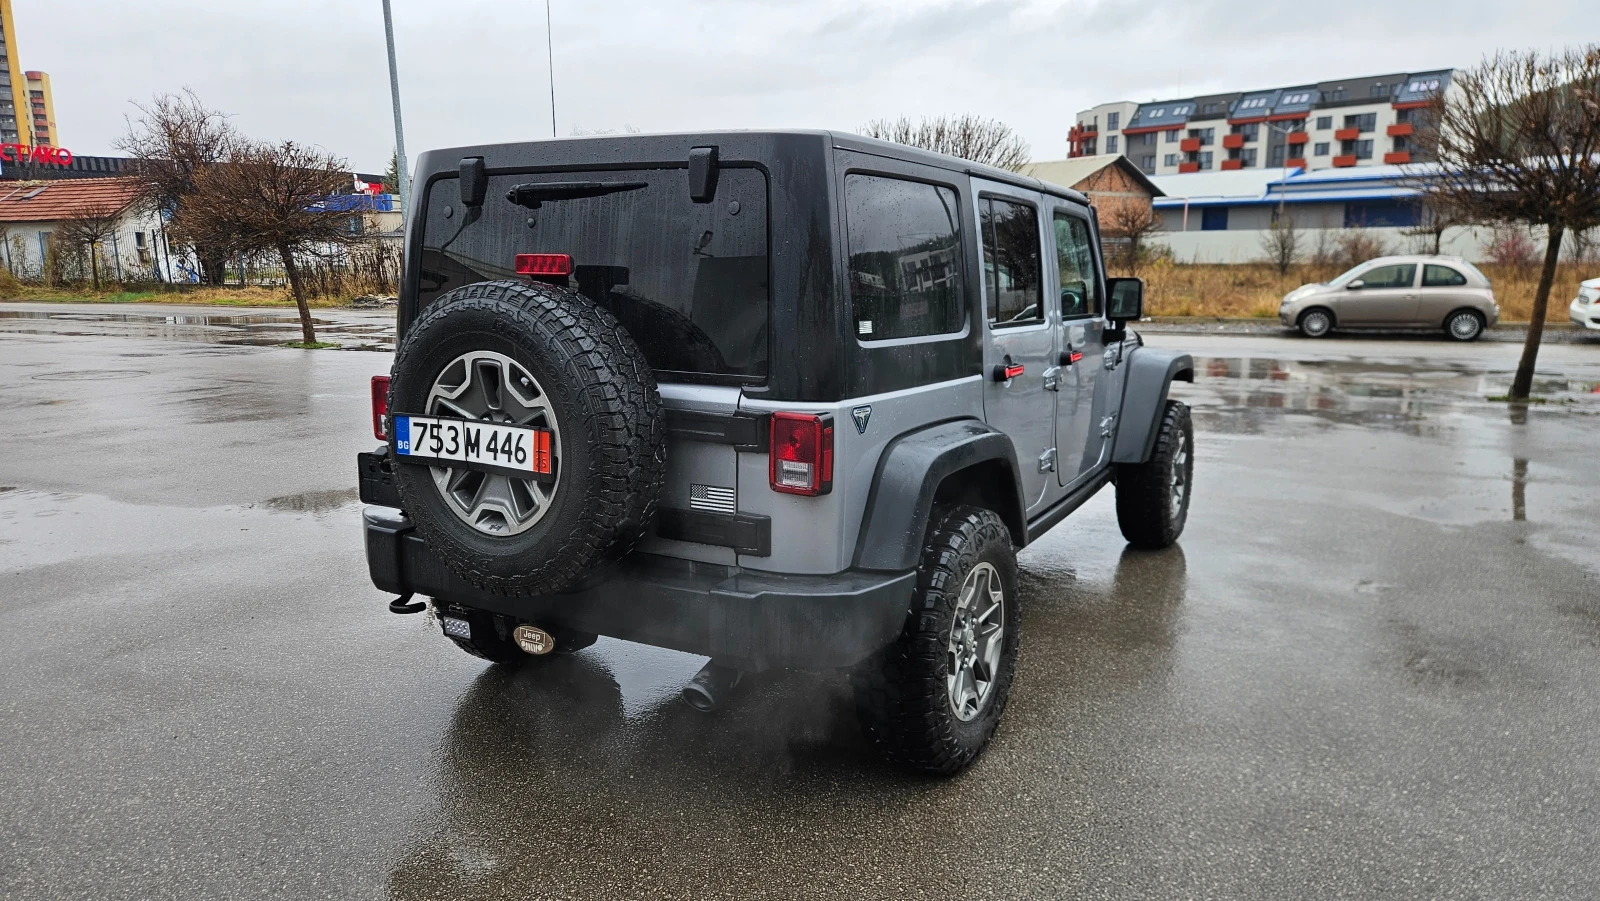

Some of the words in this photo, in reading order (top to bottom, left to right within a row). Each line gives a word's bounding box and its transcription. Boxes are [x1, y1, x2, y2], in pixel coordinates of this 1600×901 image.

[397, 440, 409, 450] BG
[413, 422, 460, 455] 753
[465, 427, 480, 458] M
[486, 432, 527, 464] 446
[523, 629, 541, 642] Jeep
